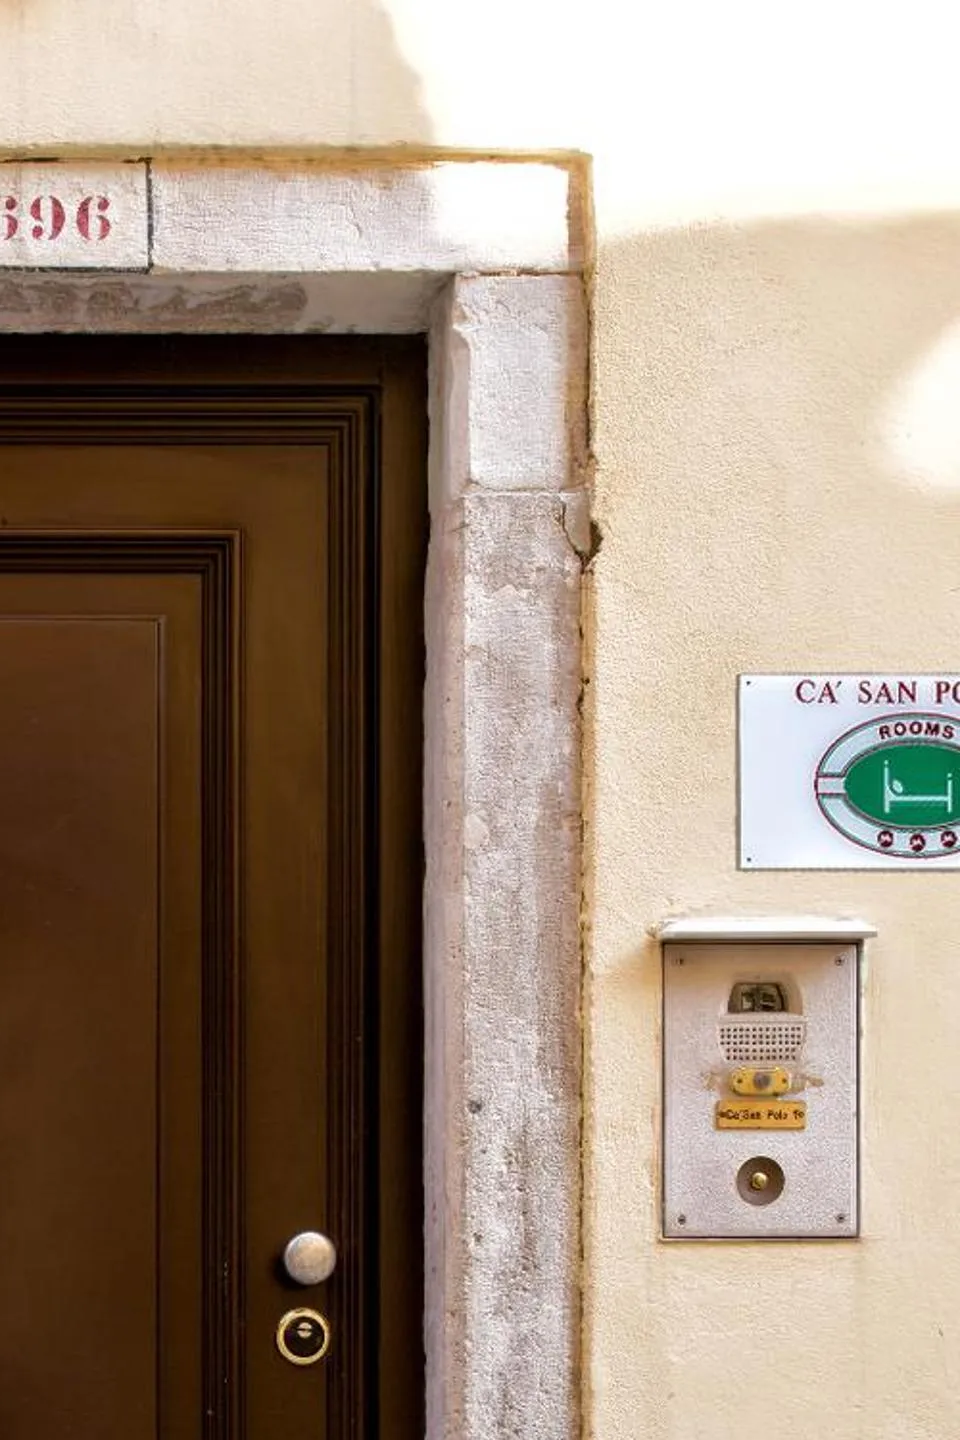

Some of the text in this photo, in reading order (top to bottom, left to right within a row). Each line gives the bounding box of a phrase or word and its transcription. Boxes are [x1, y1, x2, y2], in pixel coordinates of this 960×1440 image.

[795, 679, 842, 704] CA'
[858, 680, 917, 704] SAN
[878, 721, 955, 740] ROOMS
